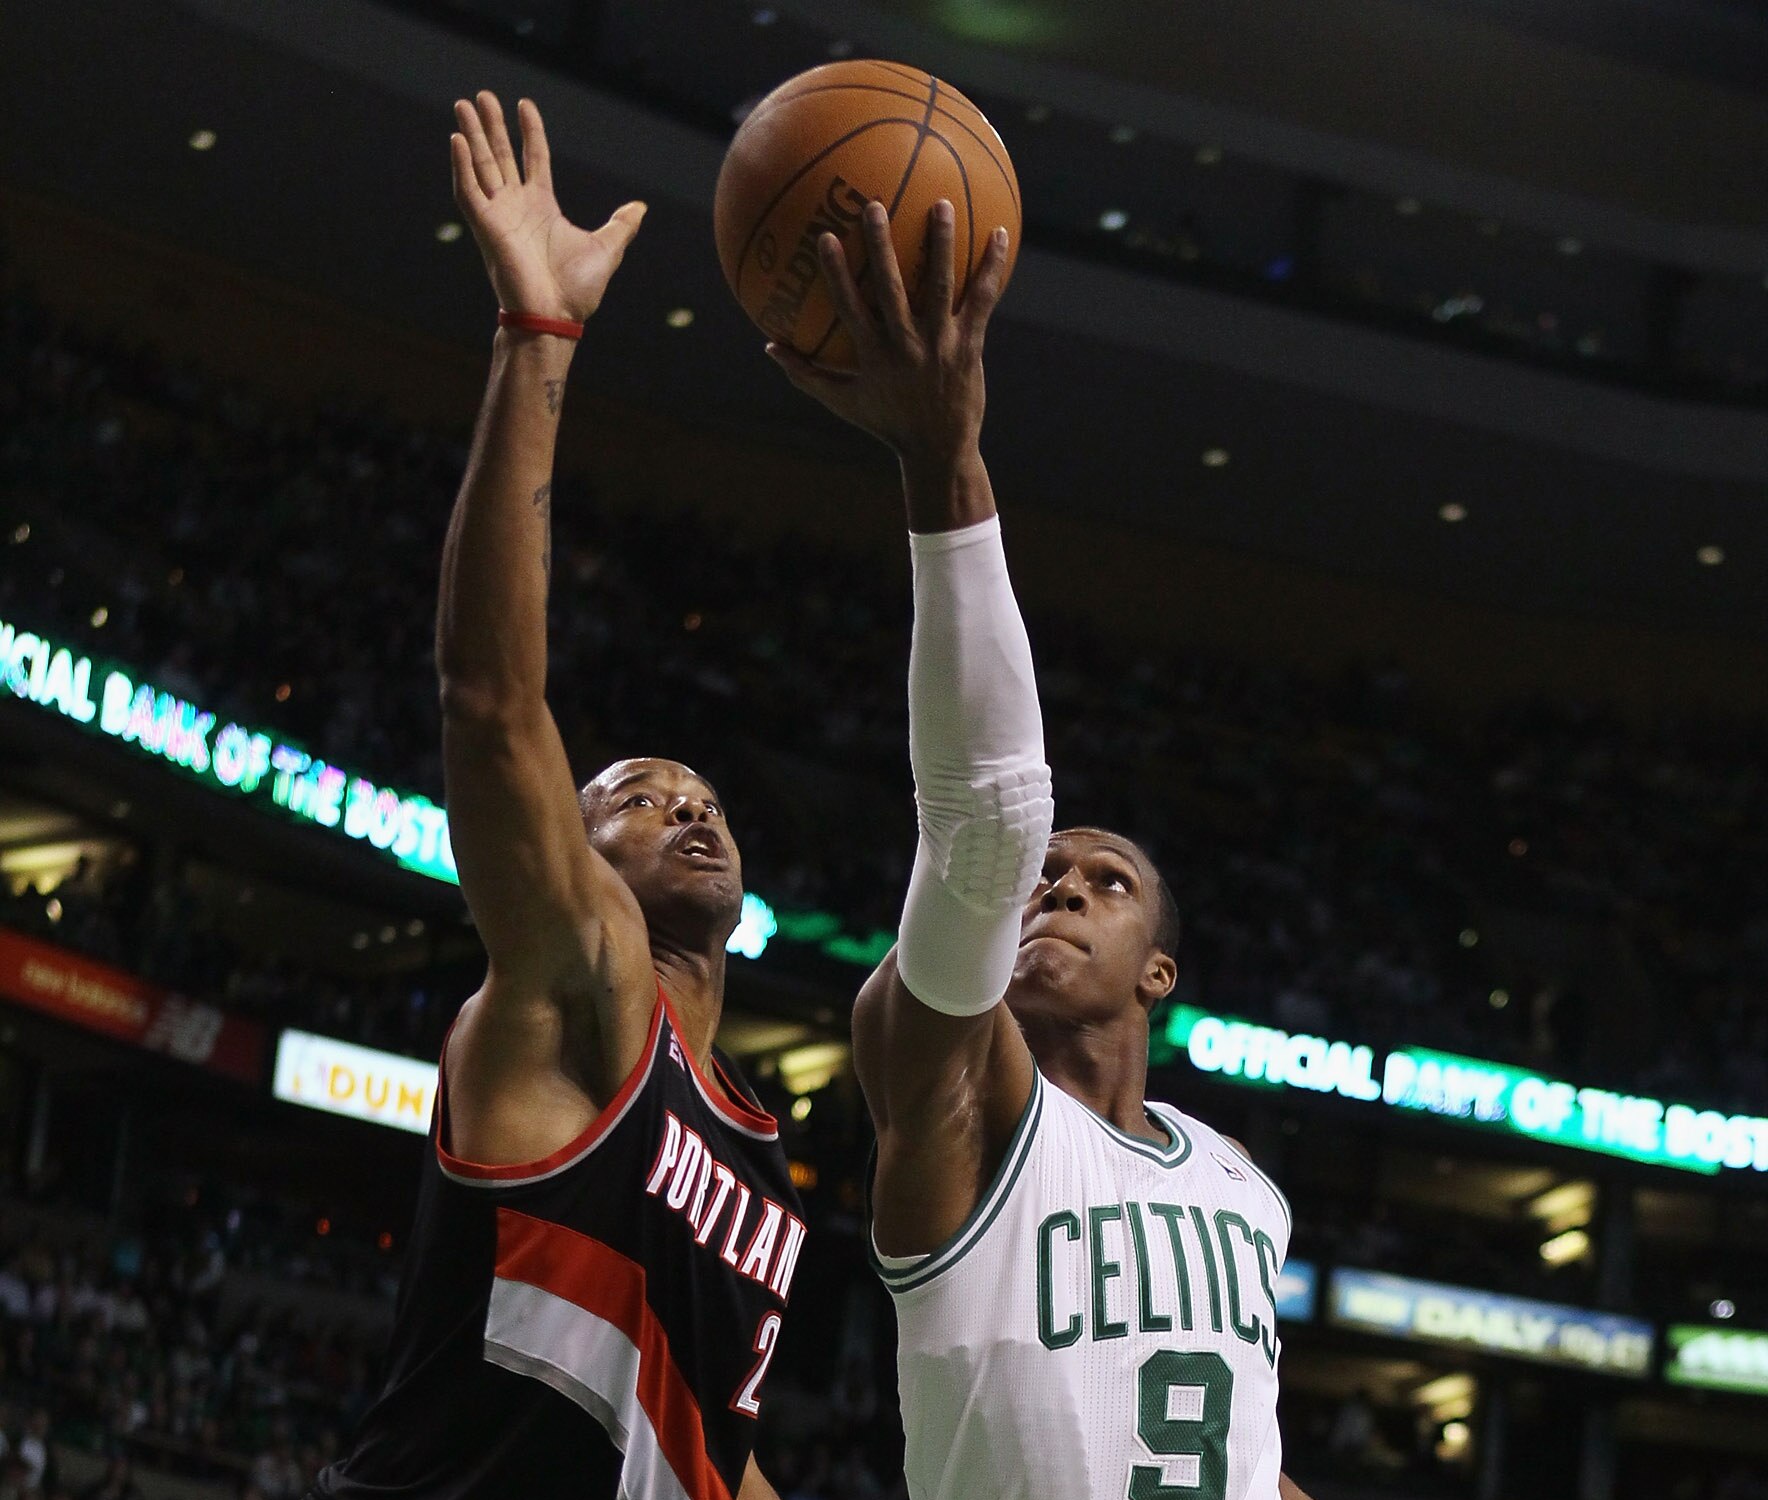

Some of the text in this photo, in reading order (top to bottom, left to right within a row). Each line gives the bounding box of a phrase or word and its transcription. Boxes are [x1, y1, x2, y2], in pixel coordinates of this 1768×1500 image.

[101, 671, 216, 773] BANK
[213, 722, 272, 793] OF
[271, 743, 347, 827] THE
[1188, 1016, 1382, 1102] OFFICIAL
[1382, 1051, 1507, 1122] BANK
[1510, 1077, 1576, 1133] OF
[1577, 1088, 1664, 1150] THE
[1037, 1200, 1279, 1370] CELTICS
